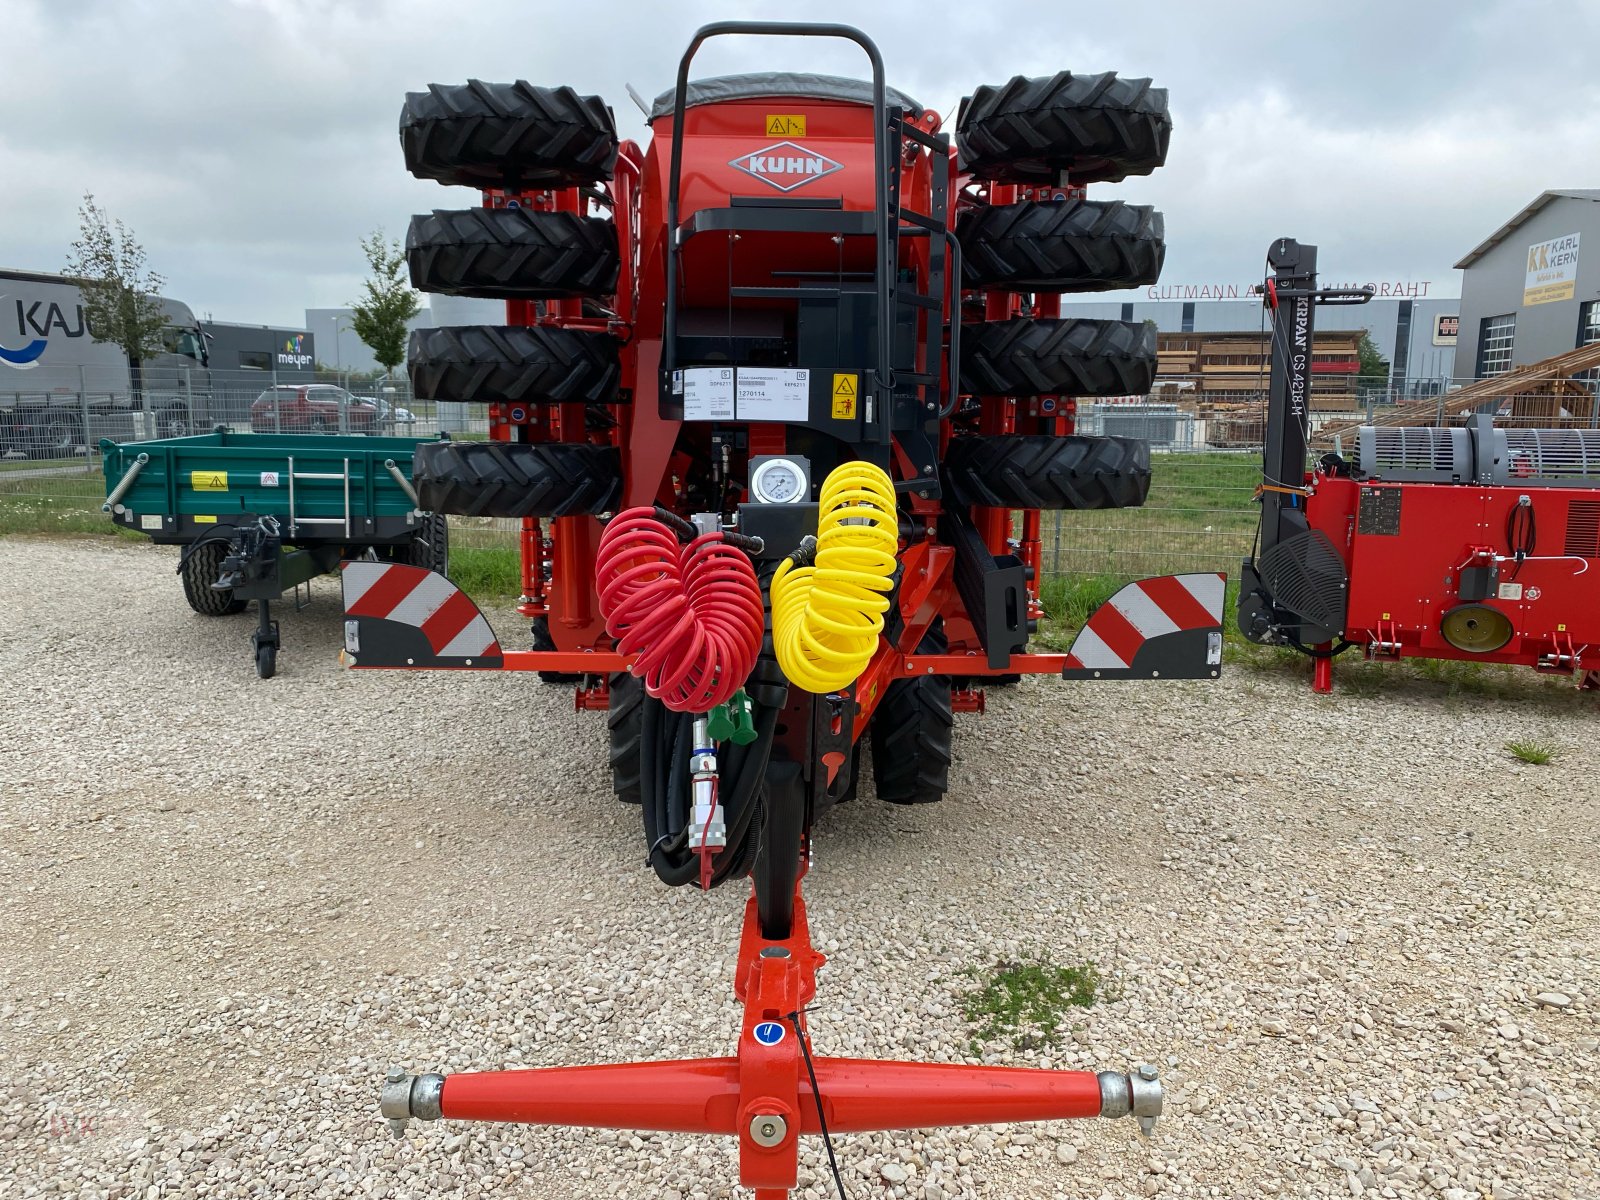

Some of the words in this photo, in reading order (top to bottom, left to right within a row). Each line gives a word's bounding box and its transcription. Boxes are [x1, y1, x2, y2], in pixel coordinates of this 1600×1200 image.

[749, 156, 823, 174] KUHN
[1551, 236, 1578, 253] KARL
[1549, 250, 1578, 268] KERN
[1147, 284, 1238, 299] GUTMANN
[278, 353, 313, 370] meyer
[1293, 354, 1306, 371] CS
[1291, 373, 1305, 403] 4218
[1291, 406, 1303, 416] M
